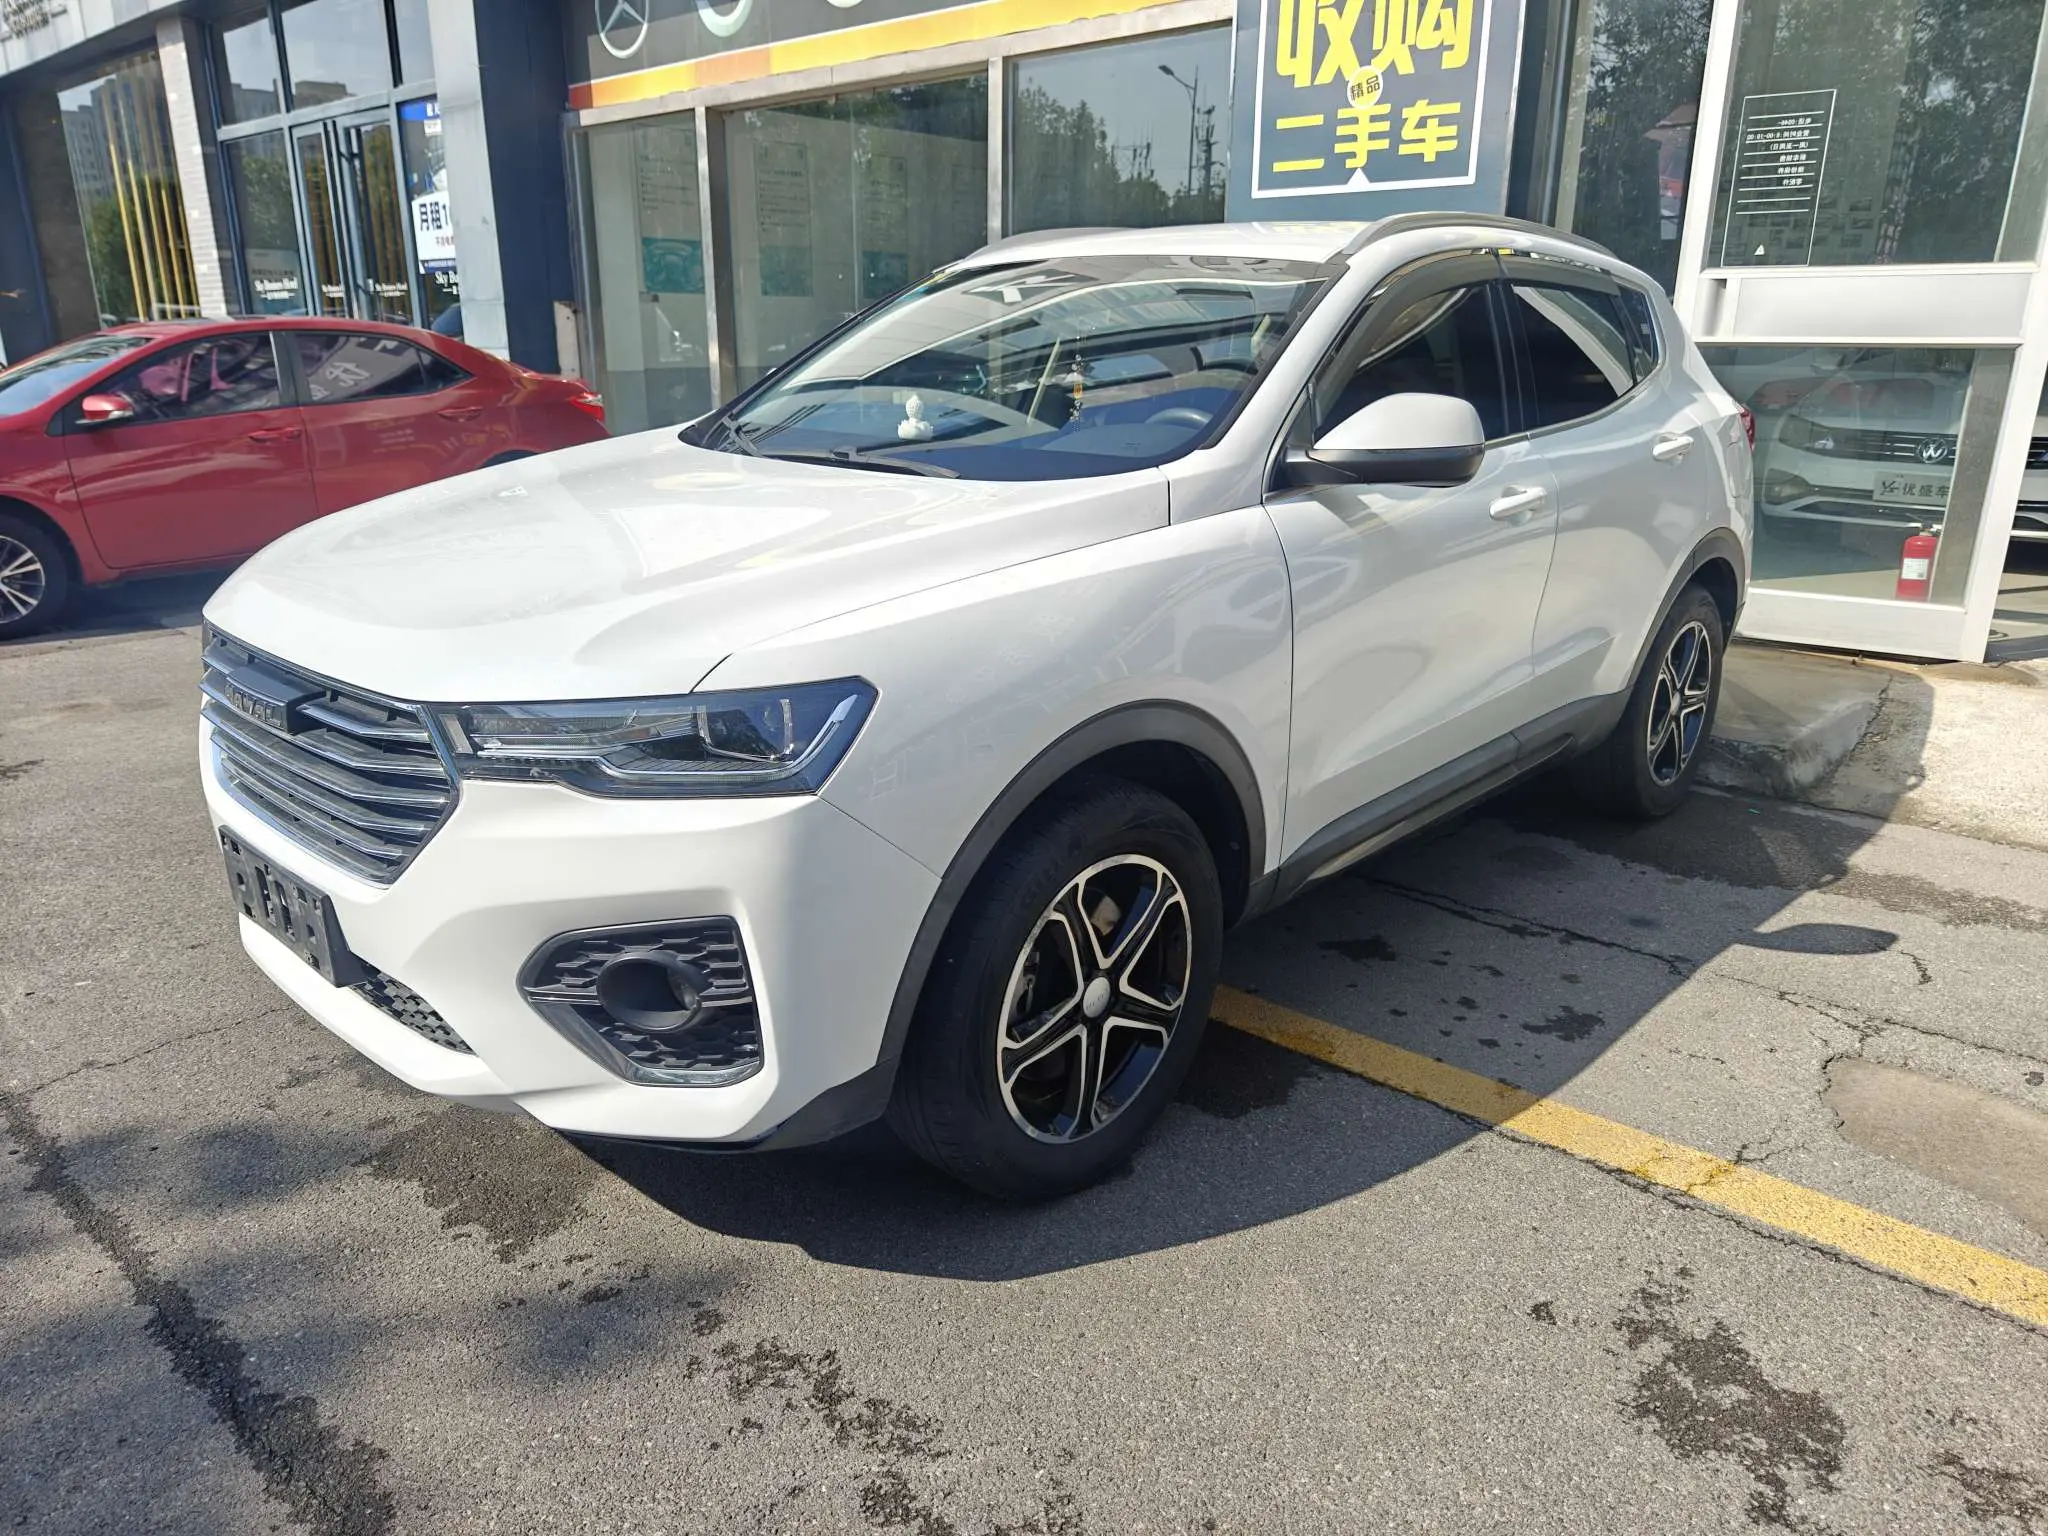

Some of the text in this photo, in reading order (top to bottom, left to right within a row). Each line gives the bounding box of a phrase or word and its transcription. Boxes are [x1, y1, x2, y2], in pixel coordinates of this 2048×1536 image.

[1276, 0, 1473, 88] 收购
[1351, 75, 1380, 101] 精品
[1272, 99, 1461, 172] 二手车
